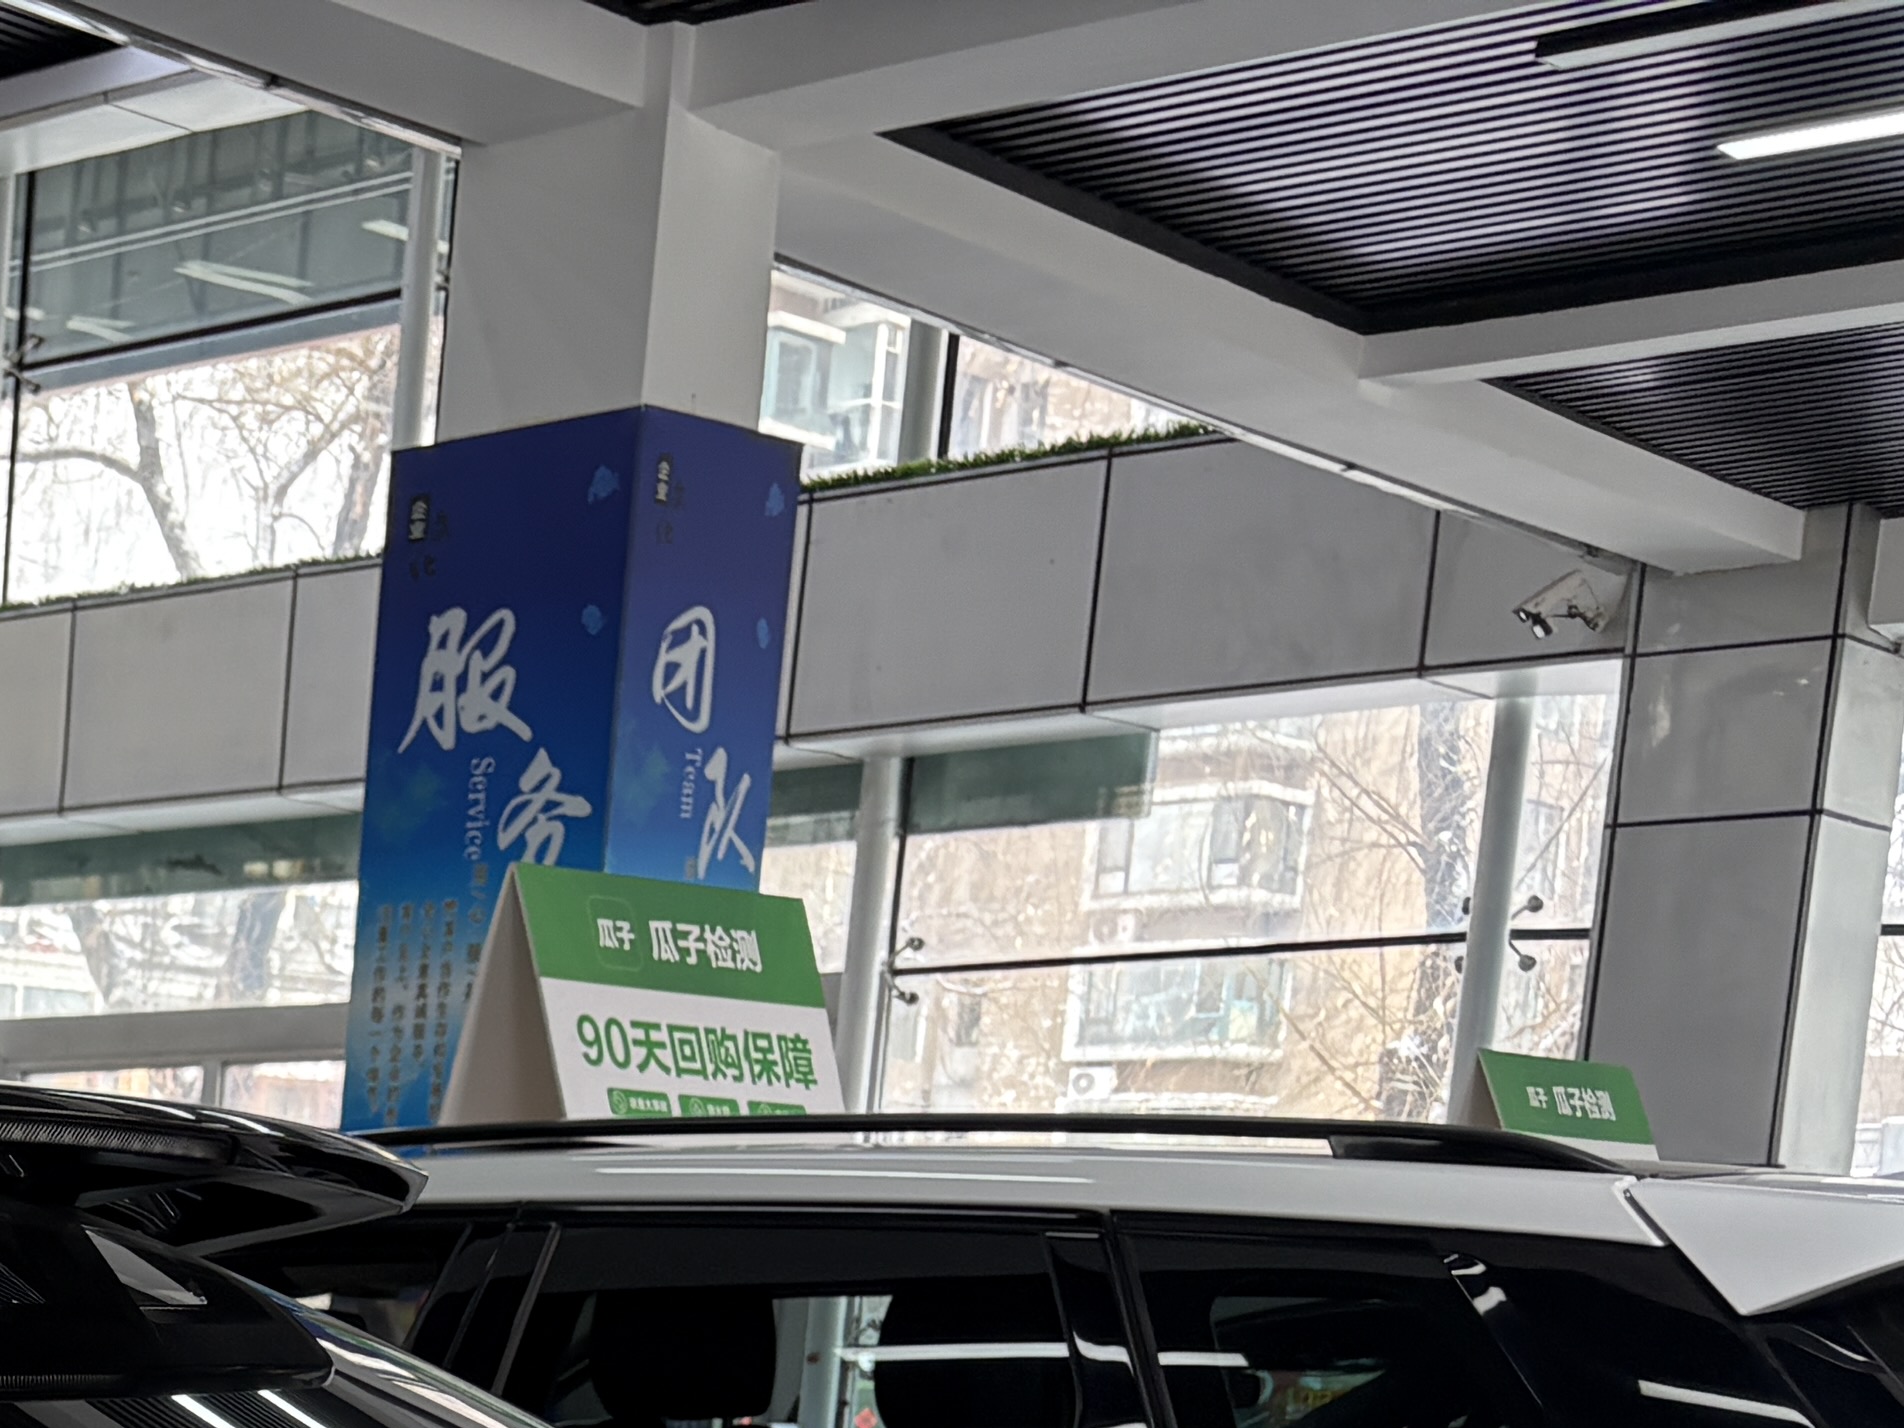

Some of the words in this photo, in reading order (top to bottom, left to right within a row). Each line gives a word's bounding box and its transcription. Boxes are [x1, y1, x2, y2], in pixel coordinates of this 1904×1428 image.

[397, 605, 593, 867] 服务
[650, 604, 756, 880] 团队
[464, 755, 497, 862] Service
[679, 747, 703, 820] Team
[596, 918, 635, 951] 瓜子
[648, 920, 763, 974] 瓜子检测
[576, 1013, 819, 1091] 90天回购保障
[1552, 1086, 1617, 1122] 瓜子检测
